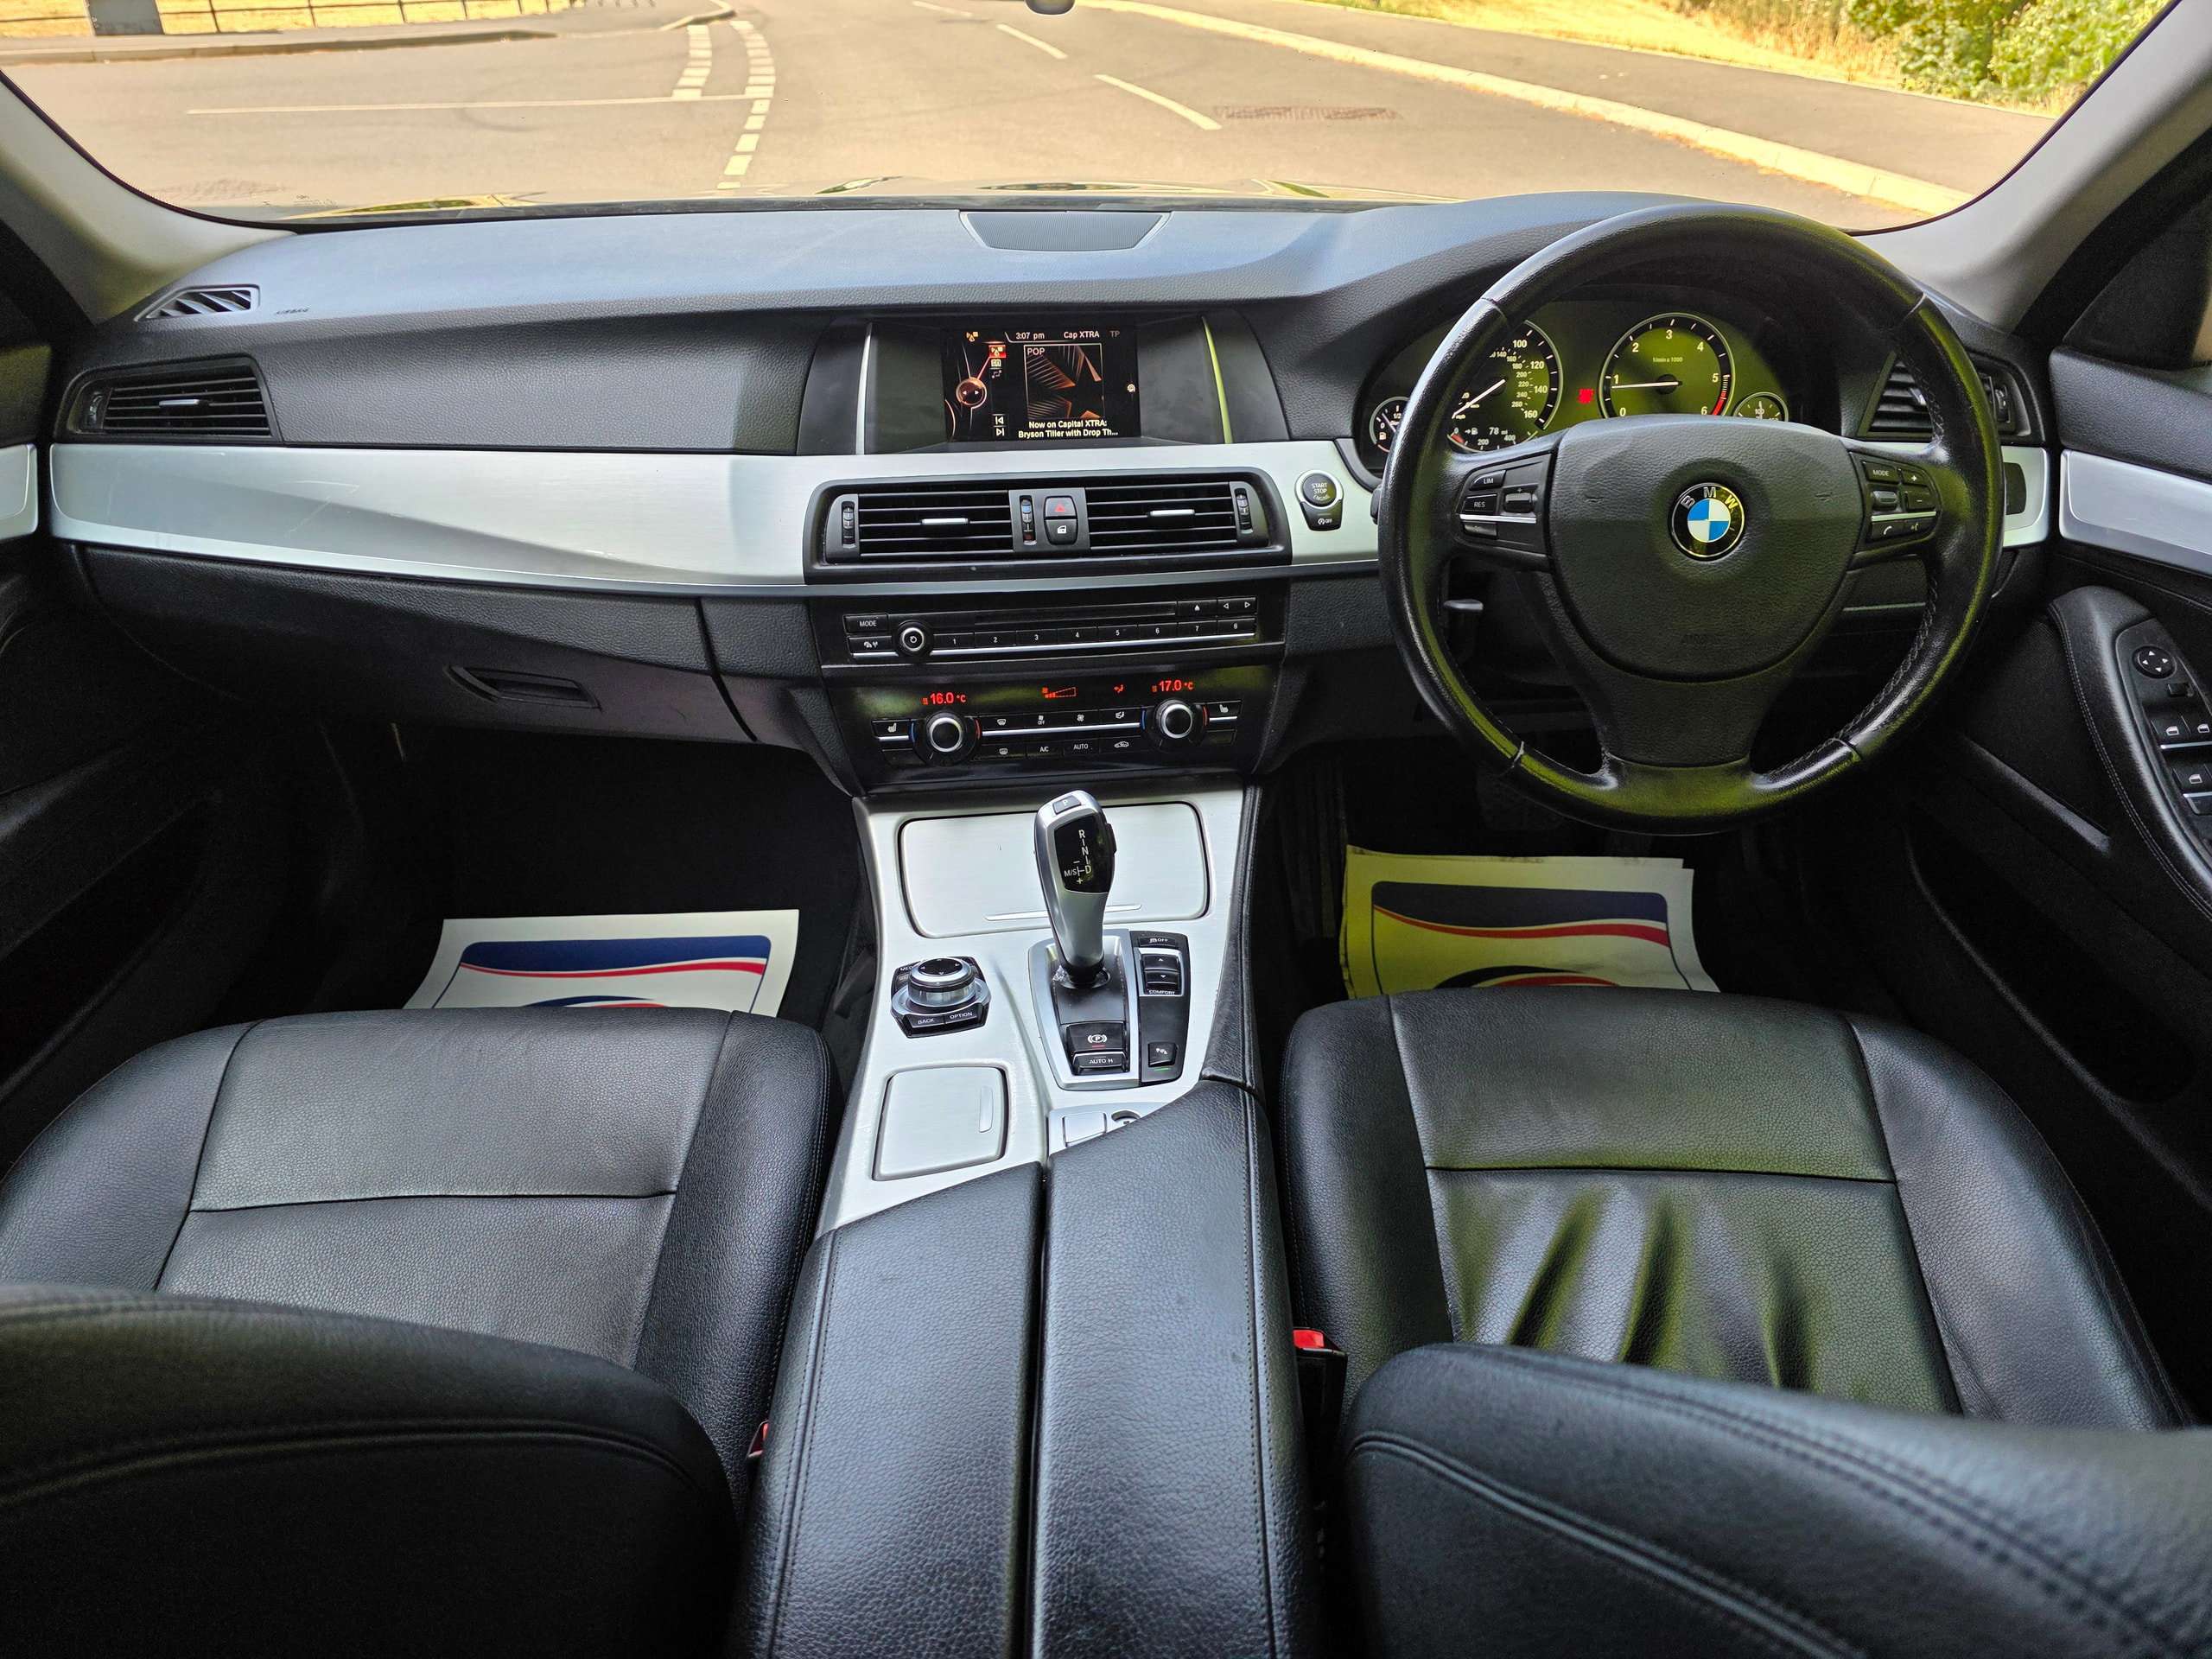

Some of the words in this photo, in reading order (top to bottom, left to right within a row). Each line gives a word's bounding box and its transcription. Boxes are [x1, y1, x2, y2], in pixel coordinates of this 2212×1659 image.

[1064, 331, 1077, 340] Cap
[1666, 329, 1673, 339] 3
[1512, 340, 1528, 348] 100
[1631, 343, 1639, 353] 2
[1697, 342, 1704, 352] 4
[1530, 360, 1545, 370] 120
[1613, 374, 1619, 385] 1
[1713, 373, 1719, 383] 5
[1534, 385, 1548, 394] 140
[1523, 410, 1538, 418] 160
[1619, 407, 1626, 417] 0
[1700, 406, 1708, 416] 6
[1058, 420, 1084, 429] Capital
[1018, 430, 1045, 440] Bryson
[1046, 429, 1065, 438] Tiller
[1083, 429, 1102, 437] Drop
[1489, 427, 1499, 435] 78
[1680, 486, 1738, 510] BMW
[859, 620, 877, 628] MODE
[1158, 679, 1183, 691] 17.0
[930, 692, 955, 705] 16.0
[1078, 829, 1086, 839] R
[1081, 845, 1089, 856] N
[1064, 868, 1077, 878] M/S
[1084, 865, 1092, 874] D
